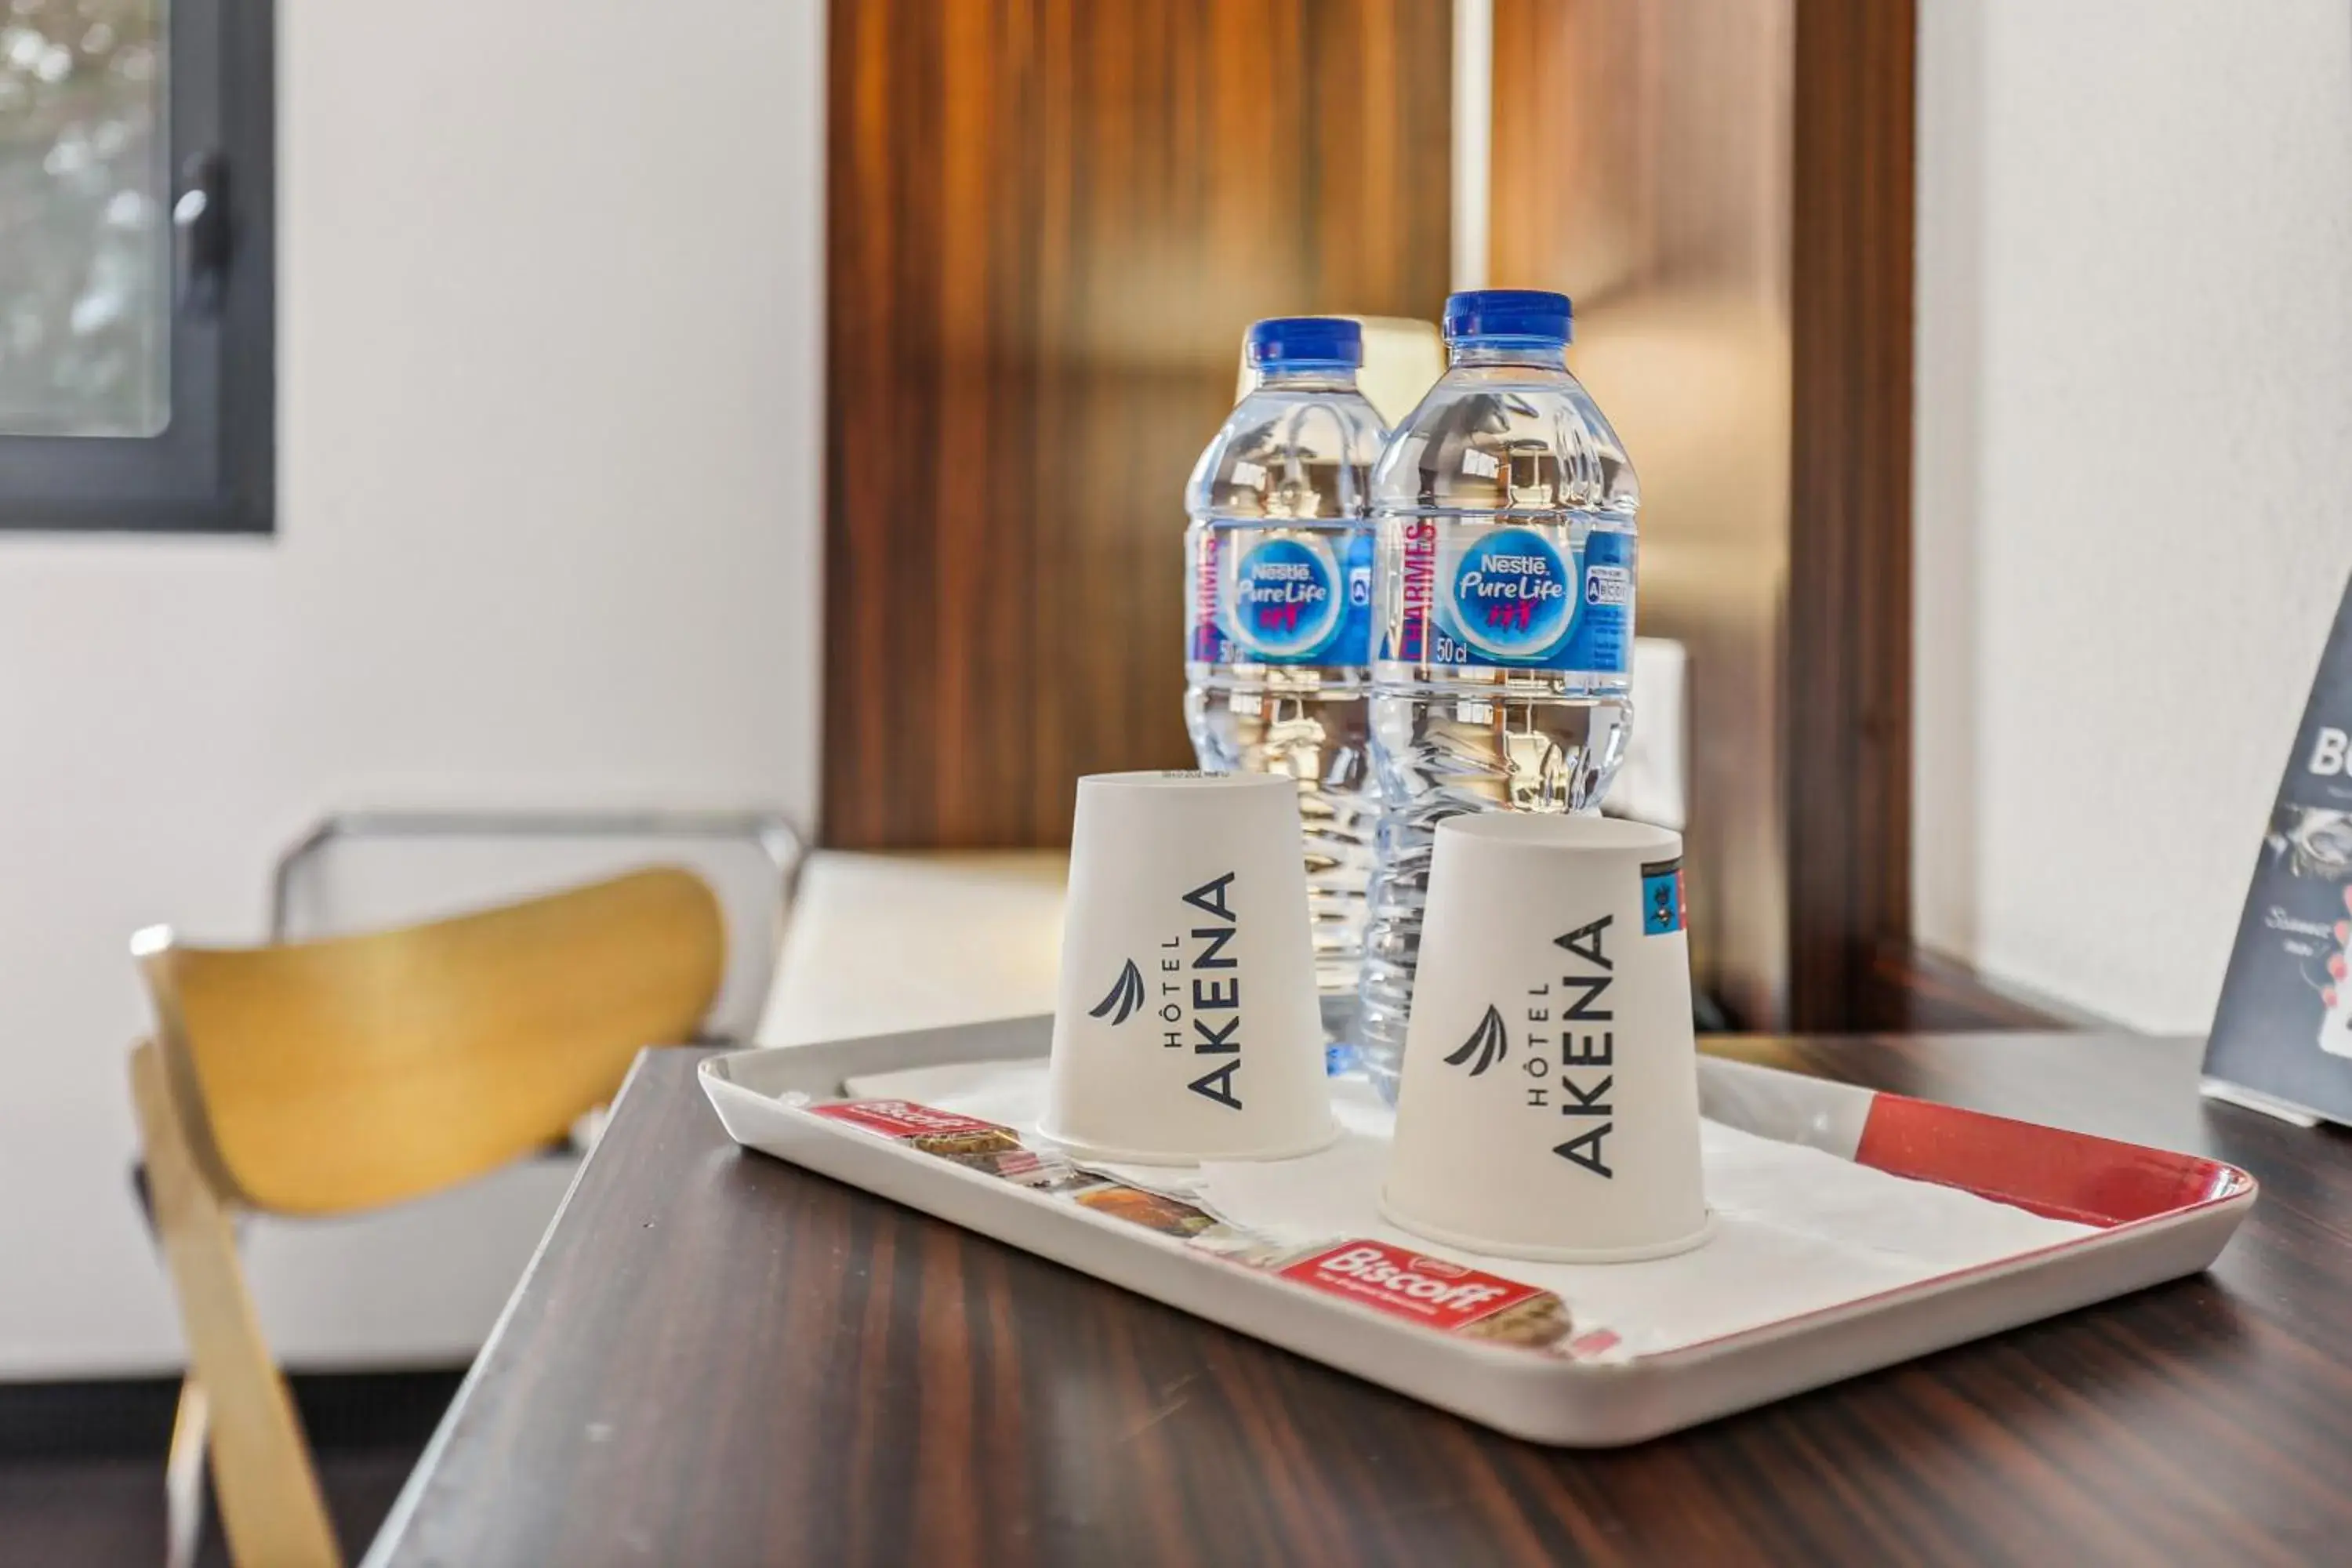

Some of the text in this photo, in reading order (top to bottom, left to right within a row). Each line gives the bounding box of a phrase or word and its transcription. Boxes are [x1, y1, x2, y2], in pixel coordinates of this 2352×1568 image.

[1251, 563, 1311, 581] Nestlé
[1481, 555, 1546, 575] Nestlé
[1436, 637, 1467, 662] 50 cl
[2308, 726, 2352, 777] B
[1159, 936, 1182, 1048] HÔTEL
[1182, 871, 1243, 1110] AKENA
[1523, 983, 1549, 1106] HÔTEL
[1552, 914, 1613, 1178] AKENA
[1319, 1247, 1507, 1311] Biscoff
